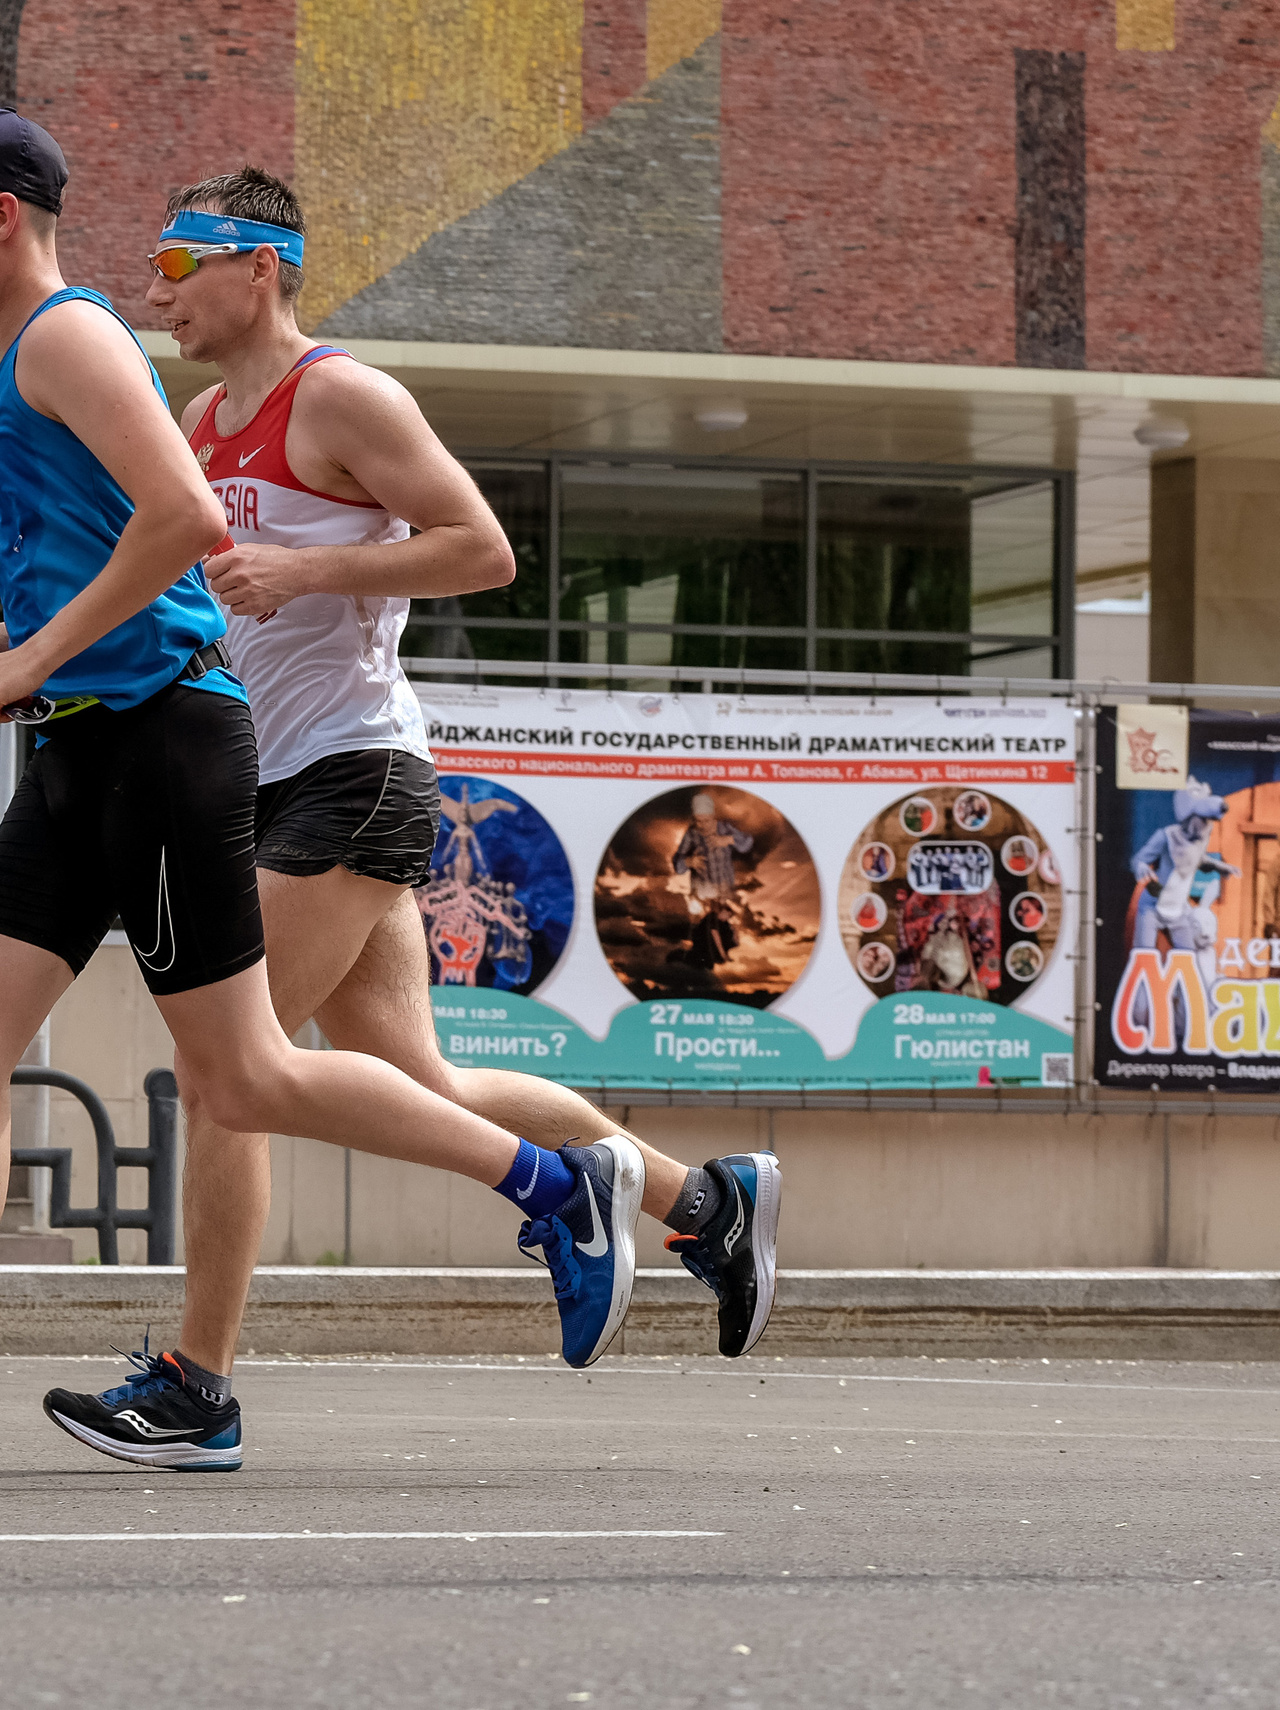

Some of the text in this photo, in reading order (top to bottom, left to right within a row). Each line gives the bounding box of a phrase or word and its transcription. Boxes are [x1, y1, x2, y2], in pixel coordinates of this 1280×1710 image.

[213, 227, 240, 237] adidas
[427, 720, 1067, 754] ЙДЖАНСКИЙ ГОСУДАРСТВЕННЫЙ ДРАМАТИЧЕСКИЙ ТЕАТР
[434, 753, 517, 770] Хакасского
[520, 758, 635, 774] национального
[638, 763, 725, 778] драмтеатра
[728, 767, 749, 777] им
[752, 764, 767, 778] А.
[846, 767, 858, 779] г.
[862, 765, 917, 780] Абакан,
[921, 767, 942, 781] ул.
[1031, 765, 1048, 779] 12
[433, 1005, 507, 1020] МАЯ 18:30
[650, 1004, 754, 1026] 27 МАЯ 18:30
[893, 1004, 924, 1024] 28
[925, 1012, 956, 1024] МАЯ
[654, 1031, 780, 1063] Прости...
[894, 1034, 1030, 1059] Гюлистан
[1107, 1060, 1169, 1079] Директор
[1171, 1064, 1216, 1080] театра
